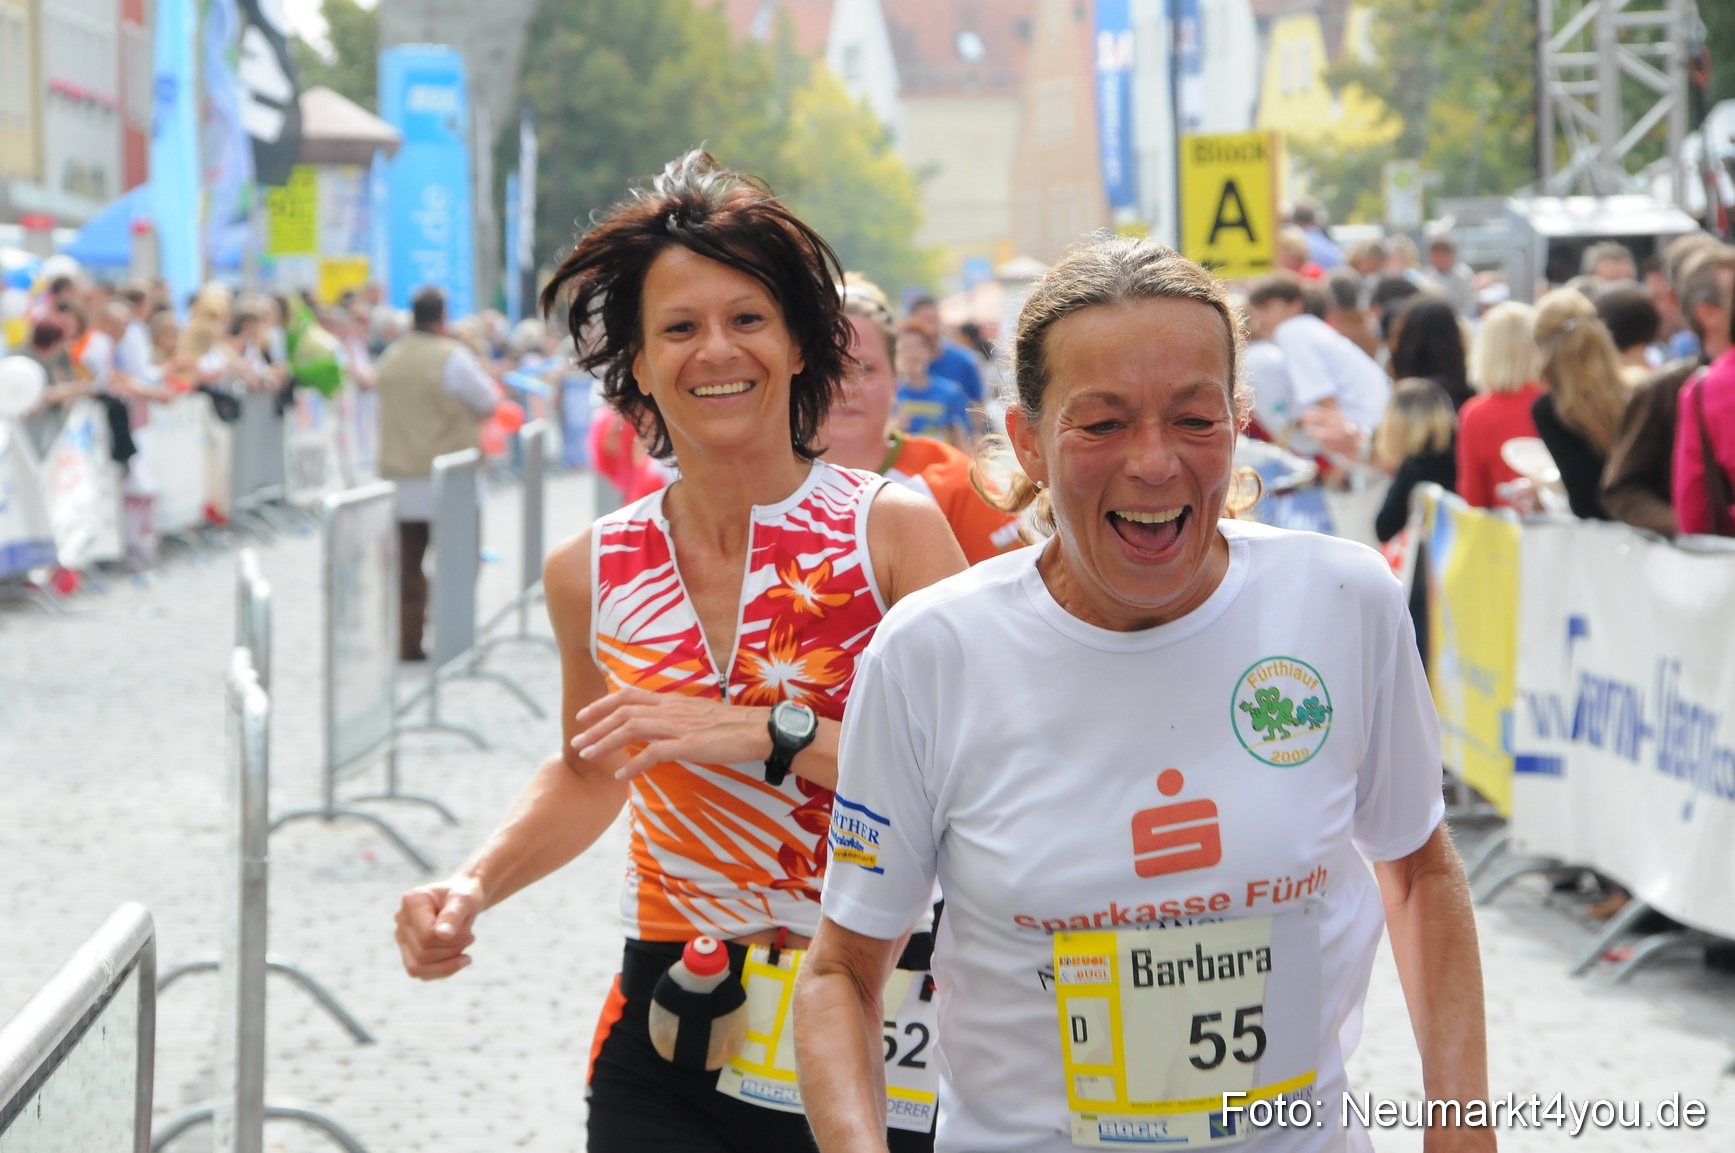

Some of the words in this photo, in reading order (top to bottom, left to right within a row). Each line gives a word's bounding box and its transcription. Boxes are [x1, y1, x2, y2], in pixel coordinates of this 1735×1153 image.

[1207, 178, 1256, 244] A
[1247, 661, 1319, 690] Fürthlauf
[1270, 747, 1310, 763] 2009
[1013, 891, 1231, 931] Sparkasse
[1245, 864, 1328, 908] Fürth
[1131, 942, 1273, 988] Barbara
[1071, 1015, 1088, 1043] D
[1189, 1005, 1267, 1070] 55
[1097, 1121, 1168, 1139] BOCK
